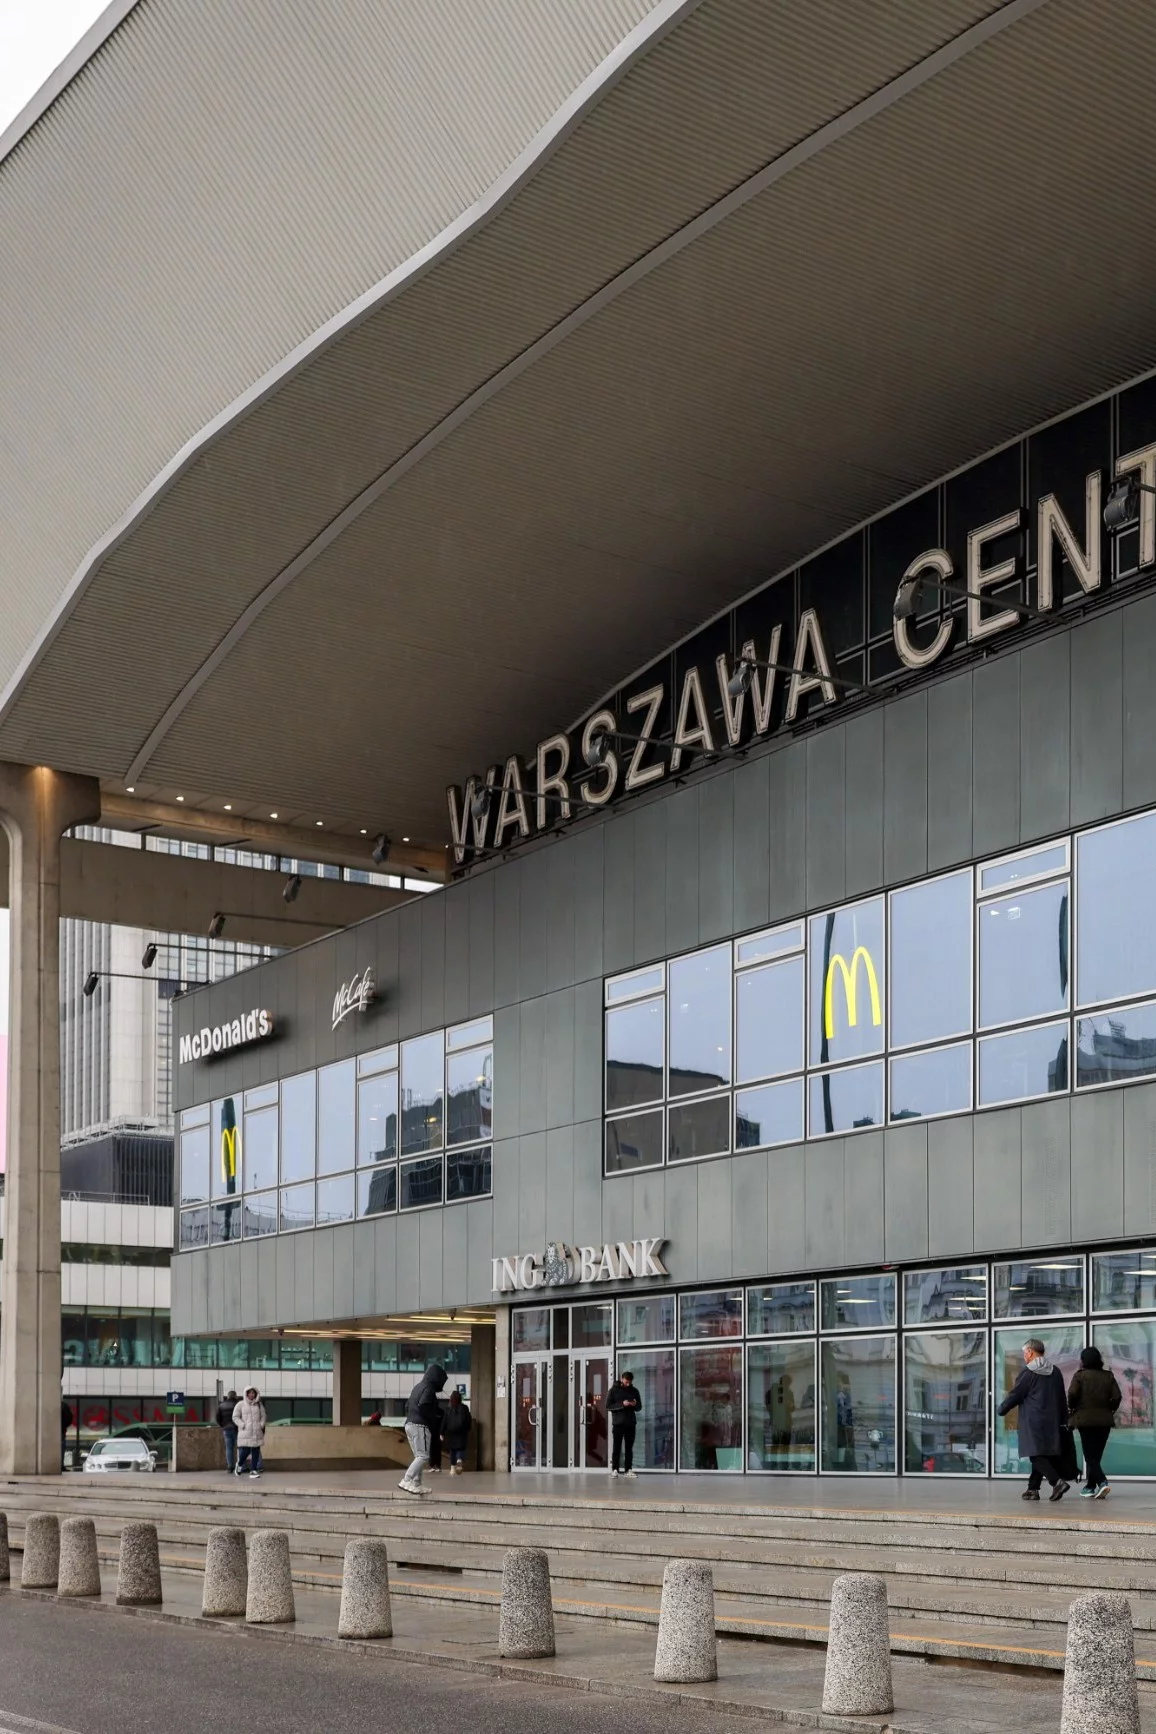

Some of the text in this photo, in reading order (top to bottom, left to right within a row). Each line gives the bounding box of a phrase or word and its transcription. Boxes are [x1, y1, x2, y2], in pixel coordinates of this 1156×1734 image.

[446, 608, 837, 864] WARSZAWA
[179, 1008, 270, 1064] McDonald's
[491, 1237, 669, 1292] ING BANK
[171, 1393, 179, 1402] P
